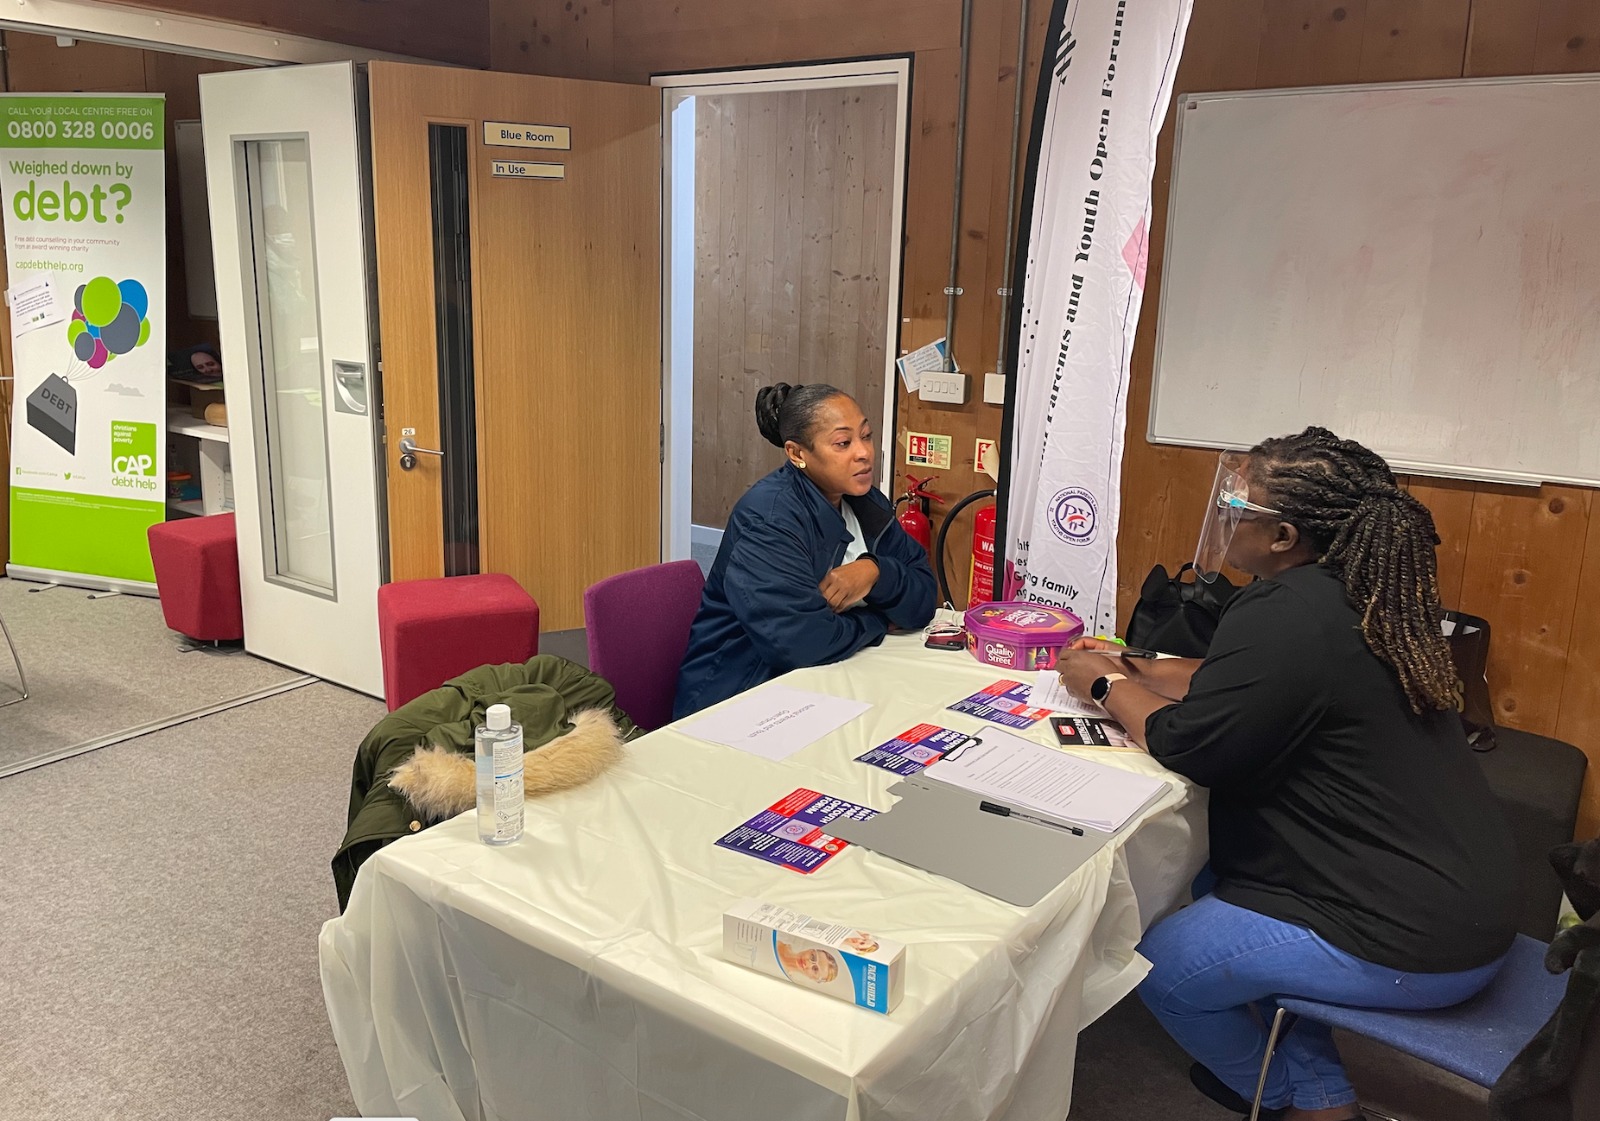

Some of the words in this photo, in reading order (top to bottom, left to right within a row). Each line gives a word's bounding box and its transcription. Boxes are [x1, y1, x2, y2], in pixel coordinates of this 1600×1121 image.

[1102, 0, 1126, 98] Forum
[8, 107, 28, 116] CALL
[30, 106, 52, 116] YOUR
[54, 107, 80, 116] LOCAL
[82, 107, 114, 116] CENTRE
[117, 108, 138, 116] FREE
[140, 108, 152, 116] ON
[8, 121, 56, 138] 0800
[62, 121, 96, 139] 328
[102, 121, 154, 140] 0006
[500, 130, 521, 140] Blue
[526, 132, 554, 142] Room
[1090, 108, 1110, 181] Open
[9, 161, 68, 176] Weighed
[71, 162, 112, 176] down
[116, 162, 133, 179] by
[496, 164, 504, 173] In
[508, 164, 525, 174] Use
[13, 180, 132, 224] debt?
[1074, 190, 1100, 263] Youth
[15, 260, 84, 272] capdebthelp.org
[1066, 274, 1084, 323] and
[40, 388, 72, 414] DEBT
[113, 454, 152, 476] CAP
[112, 476, 134, 488] debt
[136, 478, 157, 492] help
[982, 541, 994, 553] WA
[1042, 576, 1079, 600] family
[986, 644, 1015, 658] Quality
[988, 653, 1012, 665] Street
[805, 796, 833, 814] FORUM
[820, 800, 841, 814] OPEN
[820, 807, 847, 824] YOUTH
[867, 964, 876, 981] FACE
[867, 981, 876, 1007] SHIELD
